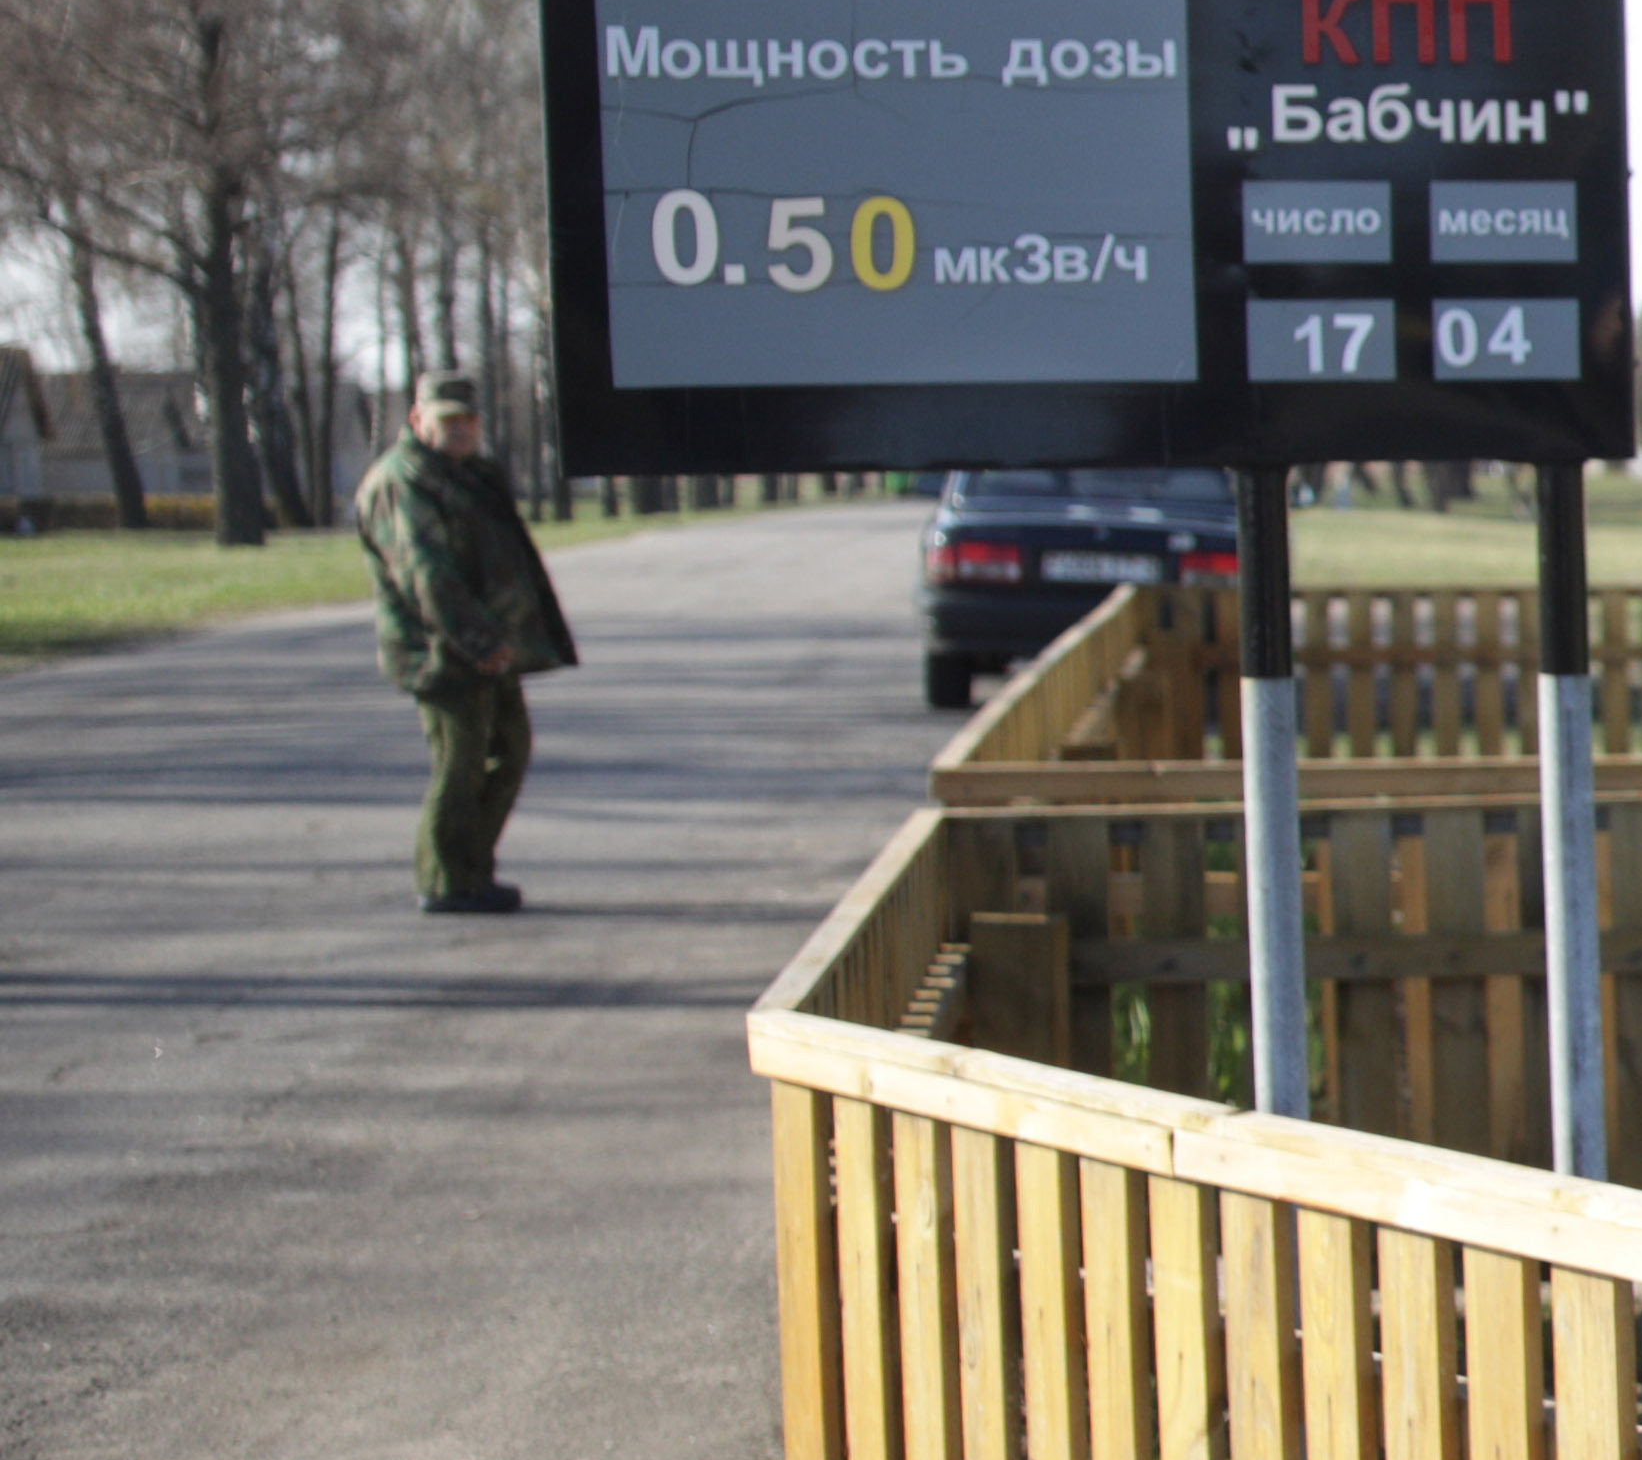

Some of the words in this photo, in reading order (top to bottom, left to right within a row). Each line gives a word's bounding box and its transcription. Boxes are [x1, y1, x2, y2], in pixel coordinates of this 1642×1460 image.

[604, 24, 968, 87] Мощность
[1001, 38, 1178, 88] дозы
[650, 188, 916, 291] 0.50
[932, 232, 1150, 285] мкЗв/ч
[1250, 206, 1383, 236] число
[1437, 206, 1571, 240] месяц
[1292, 311, 1376, 375] 17
[1436, 304, 1534, 369] 04
